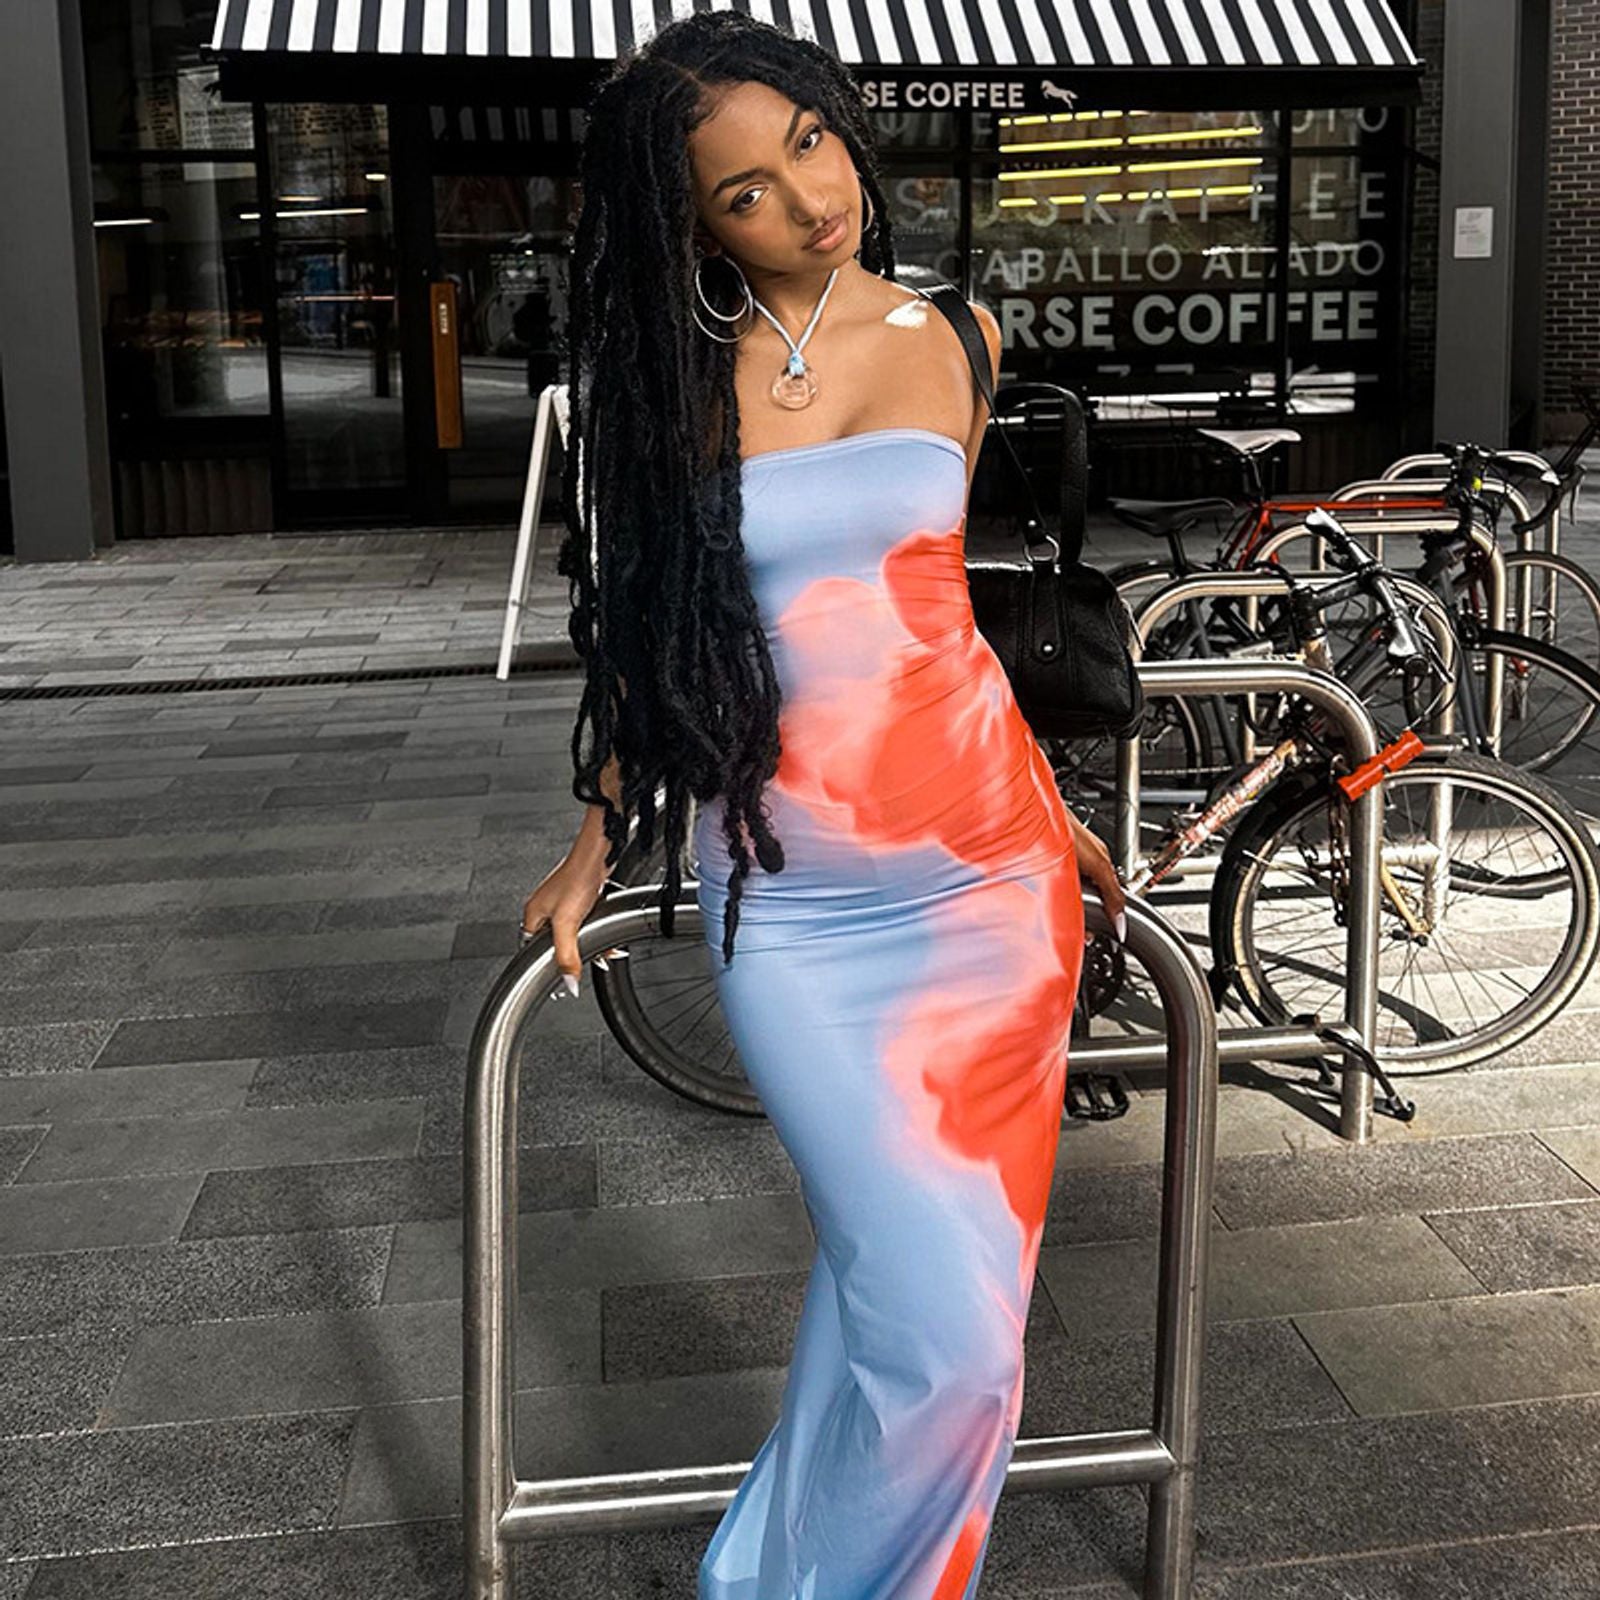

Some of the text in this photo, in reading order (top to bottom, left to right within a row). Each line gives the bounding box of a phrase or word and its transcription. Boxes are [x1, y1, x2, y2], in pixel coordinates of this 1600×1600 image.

[905, 81, 1025, 108] COFFEE
[1201, 238, 1386, 281] ALADO
[1132, 291, 1378, 346] COFFEE
